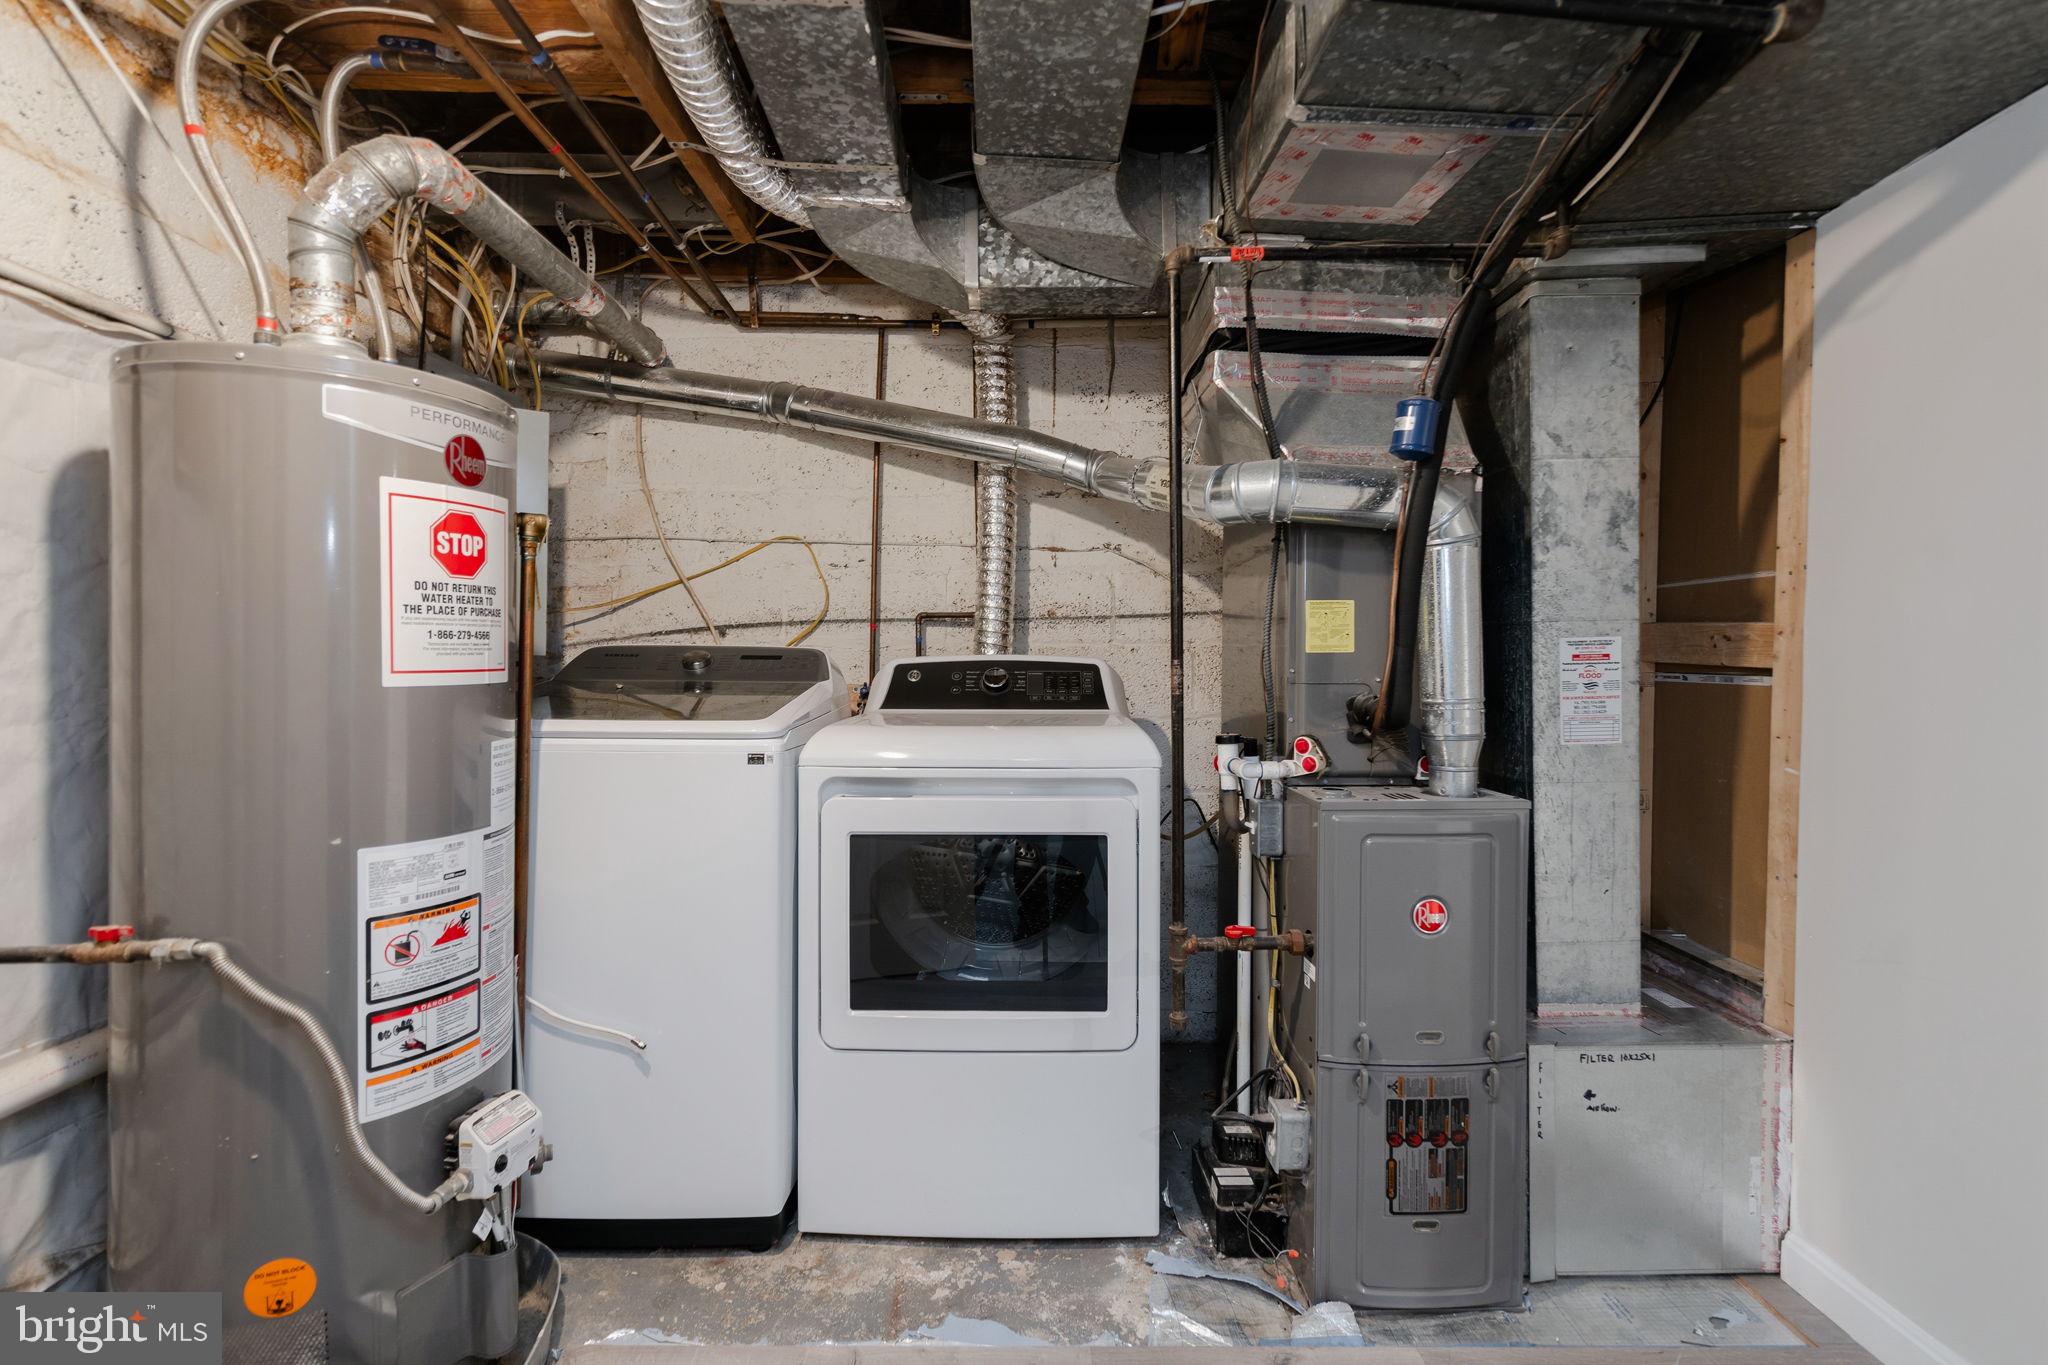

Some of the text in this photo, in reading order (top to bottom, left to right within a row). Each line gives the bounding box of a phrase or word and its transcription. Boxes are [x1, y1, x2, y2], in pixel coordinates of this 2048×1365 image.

[410, 405, 505, 443] PERFORMANCE
[449, 436, 485, 479] Rheem
[436, 531, 484, 557] STOP
[414, 581, 497, 596] DO NOT RETURN THIS
[421, 593, 493, 607] WATER HEATER TO
[403, 604, 502, 618] THE PLACE OF PURCHASE
[427, 630, 491, 640] 1-866-279-4566
[420, 995, 453, 1011] DANGER
[421, 1052, 454, 1070] WARNING
[1580, 1053, 1615, 1064] FILTER
